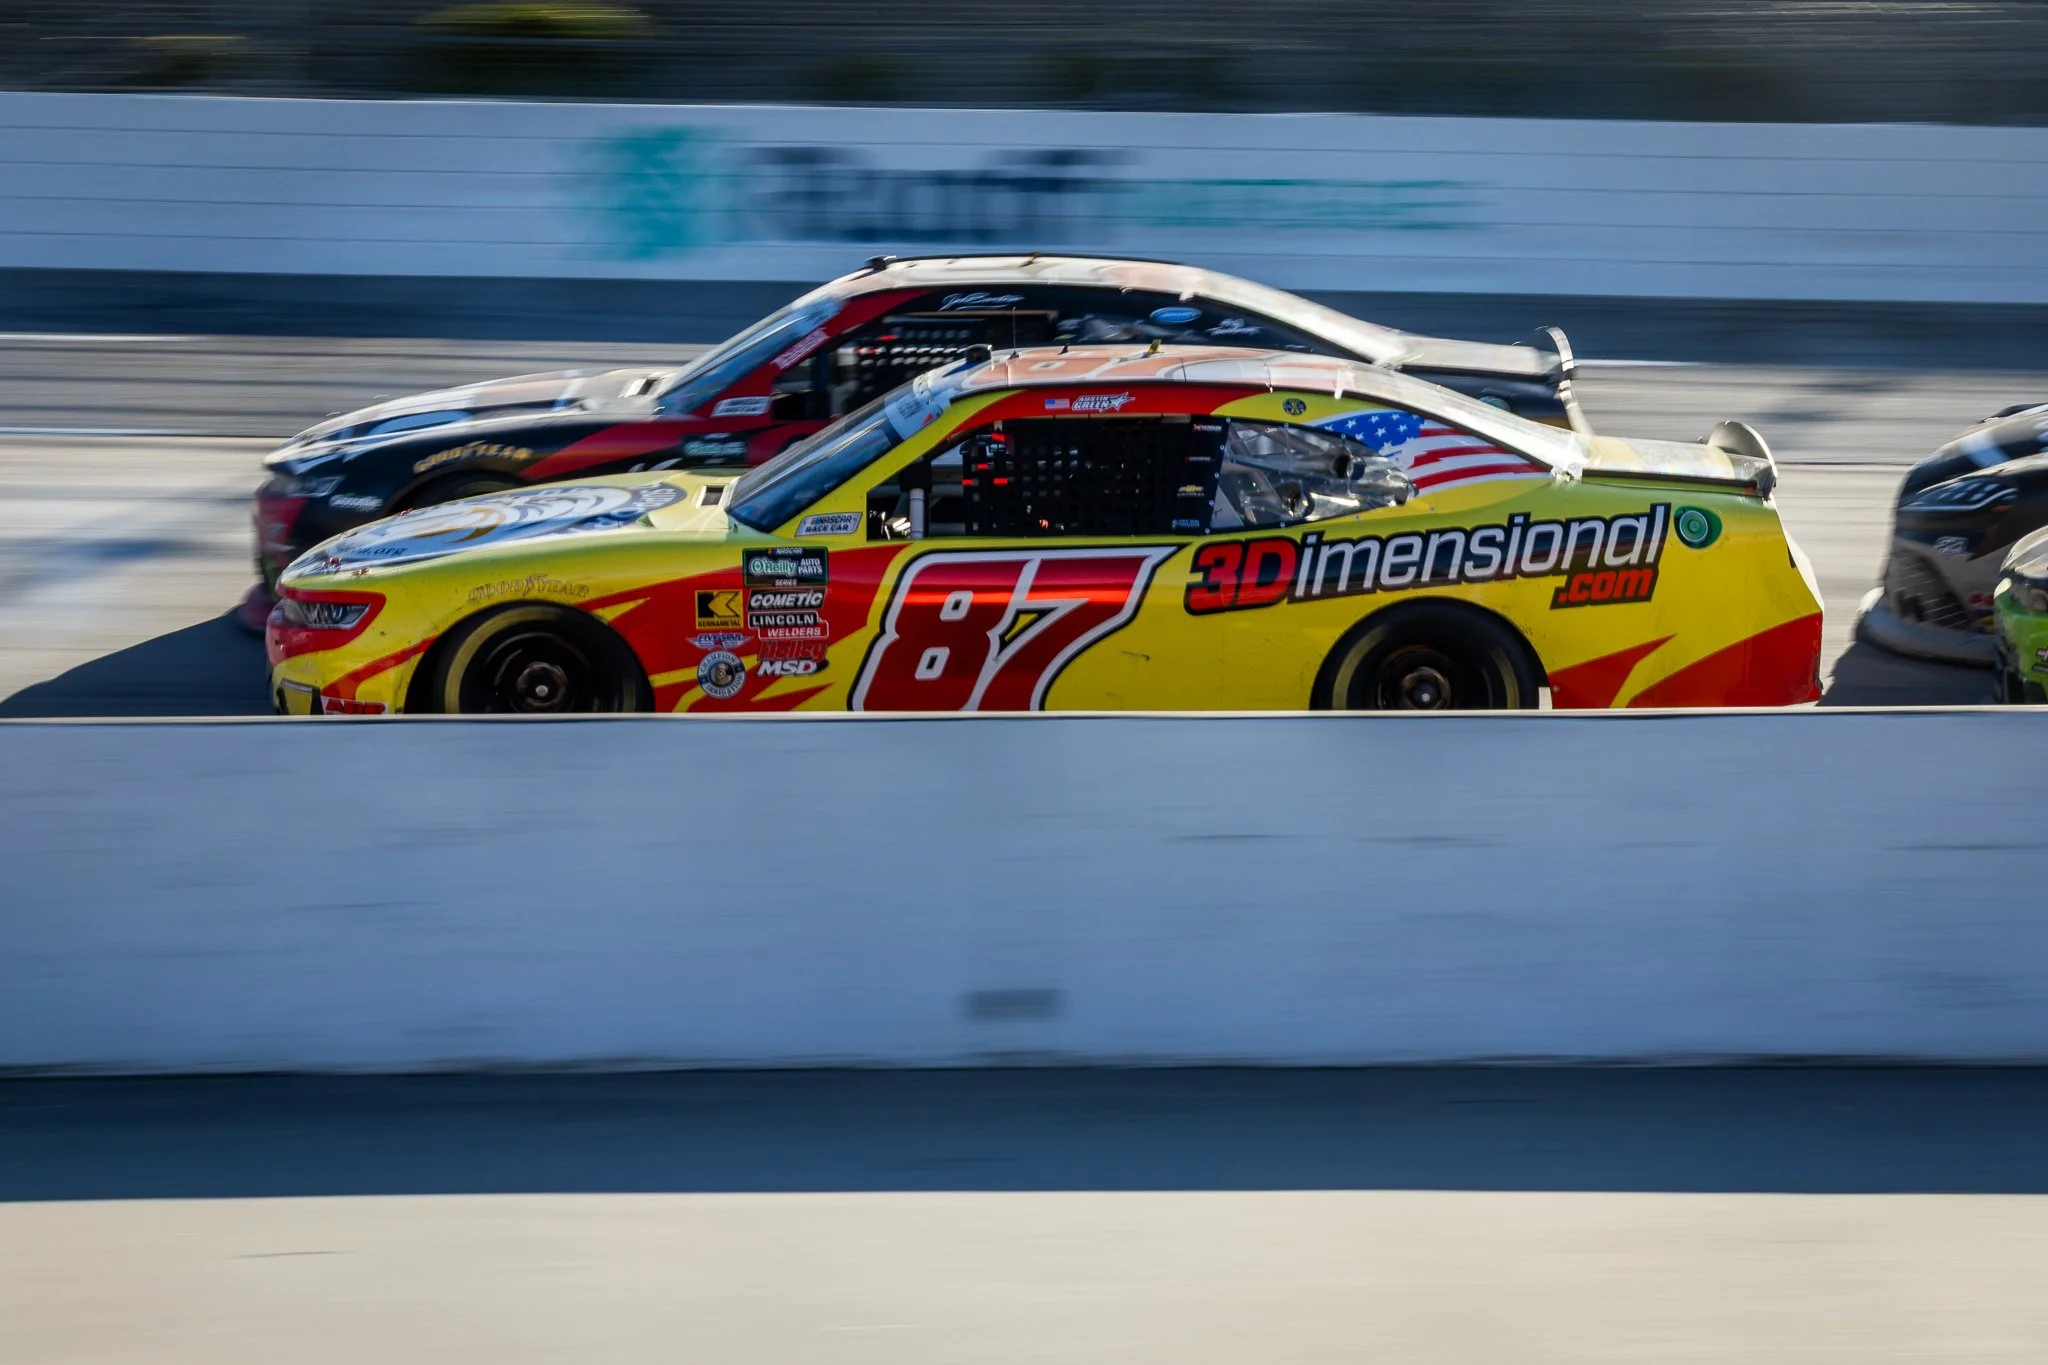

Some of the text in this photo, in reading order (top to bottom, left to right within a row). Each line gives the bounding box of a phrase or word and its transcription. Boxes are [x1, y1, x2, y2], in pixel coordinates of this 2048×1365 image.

[1072, 401, 1110, 411] GREEN
[818, 514, 853, 524] NASCAR
[805, 524, 849, 533] RACE CAR
[775, 547, 803, 555] NASCAR
[800, 558, 821, 567] AUTO
[1185, 503, 1670, 614] 3Dimensional
[749, 557, 798, 576] O'Reilly
[798, 566, 823, 576] PARTS
[775, 579, 798, 587] SERIES
[1556, 568, 1652, 605] .com
[750, 592, 823, 607] COMETIC
[697, 619, 741, 628] KENNAMETAL
[751, 614, 814, 627] LINCOLN
[767, 627, 821, 638] WELDERS
[848, 543, 1190, 711] 87
[757, 639, 828, 661] Holley
[700, 651, 737, 672] CHAMPION
[757, 660, 818, 677] MSD
